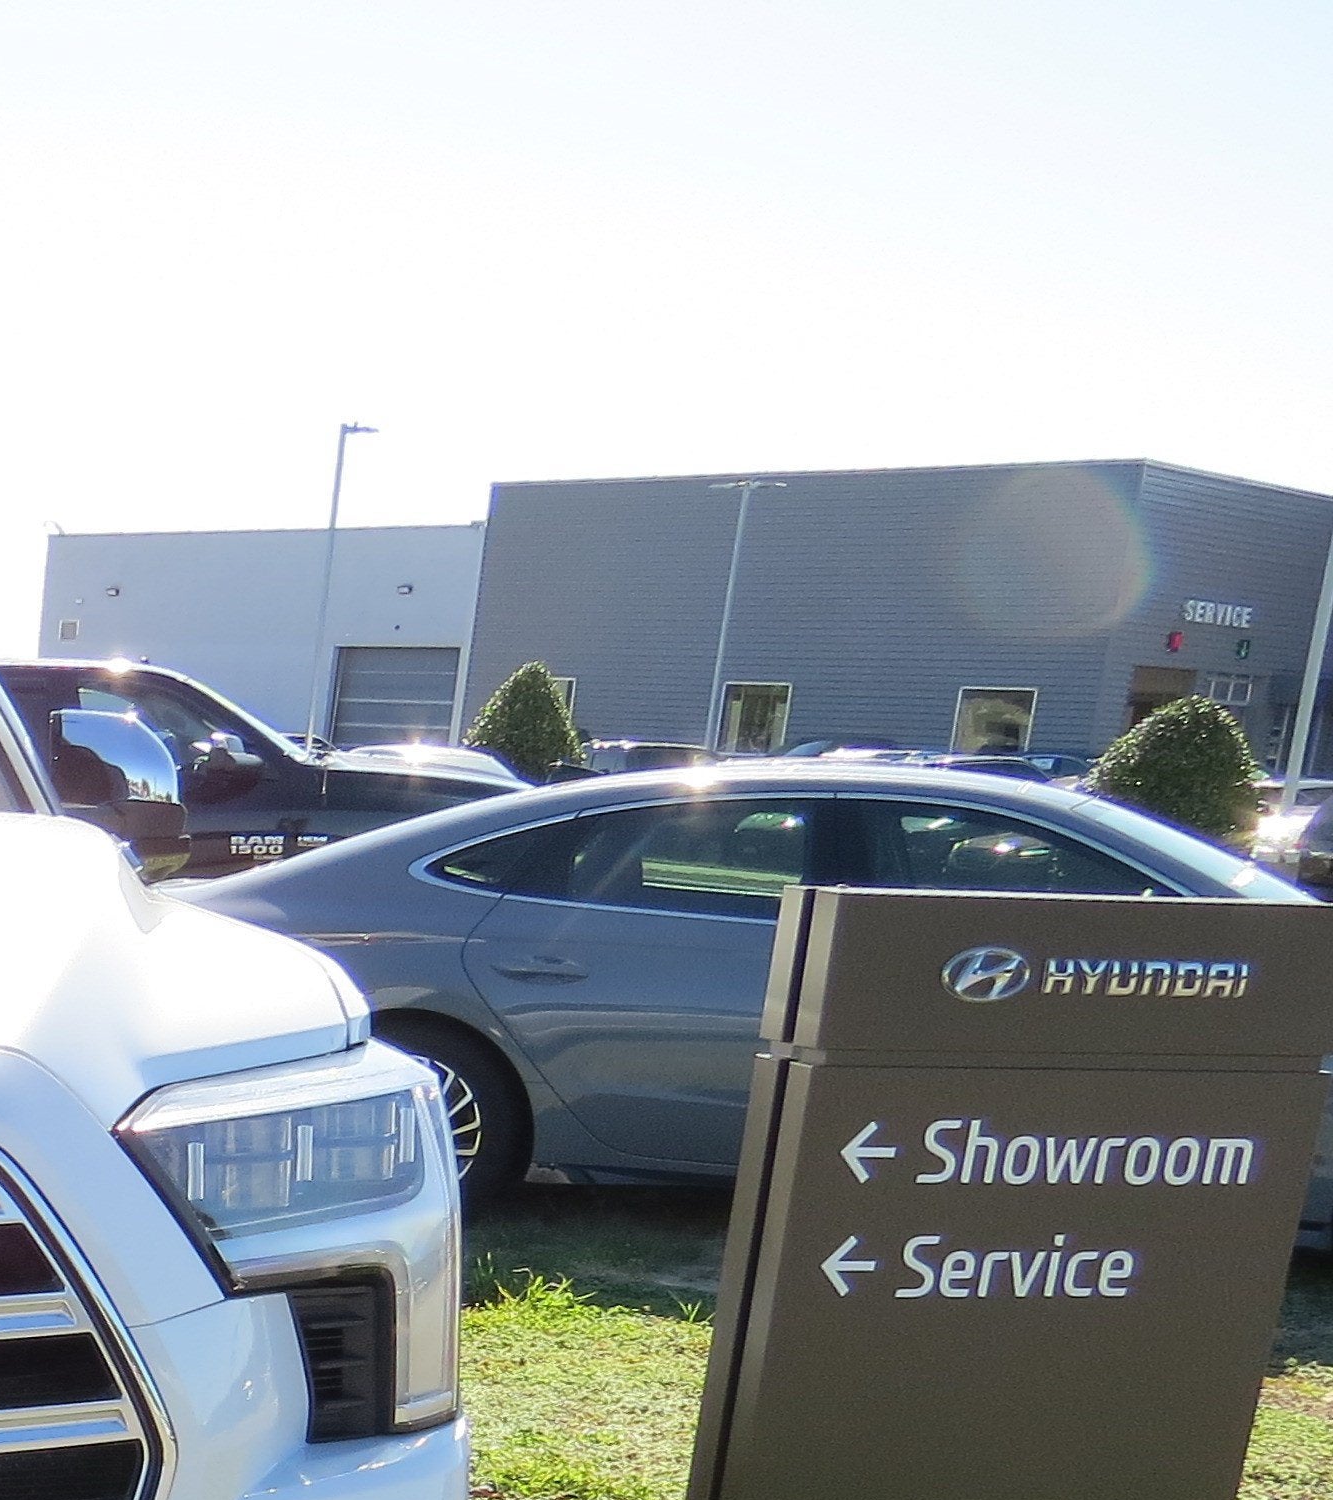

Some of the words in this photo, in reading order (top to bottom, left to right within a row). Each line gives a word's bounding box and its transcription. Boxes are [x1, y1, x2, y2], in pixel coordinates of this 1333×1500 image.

[1183, 599, 1253, 629] SERVICE
[230, 835, 285, 845] RAM
[230, 845, 284, 855] 1500
[1042, 958, 1250, 998] HYUNDAI
[914, 1118, 1255, 1186] Showroom
[894, 1233, 1134, 1299] Service
